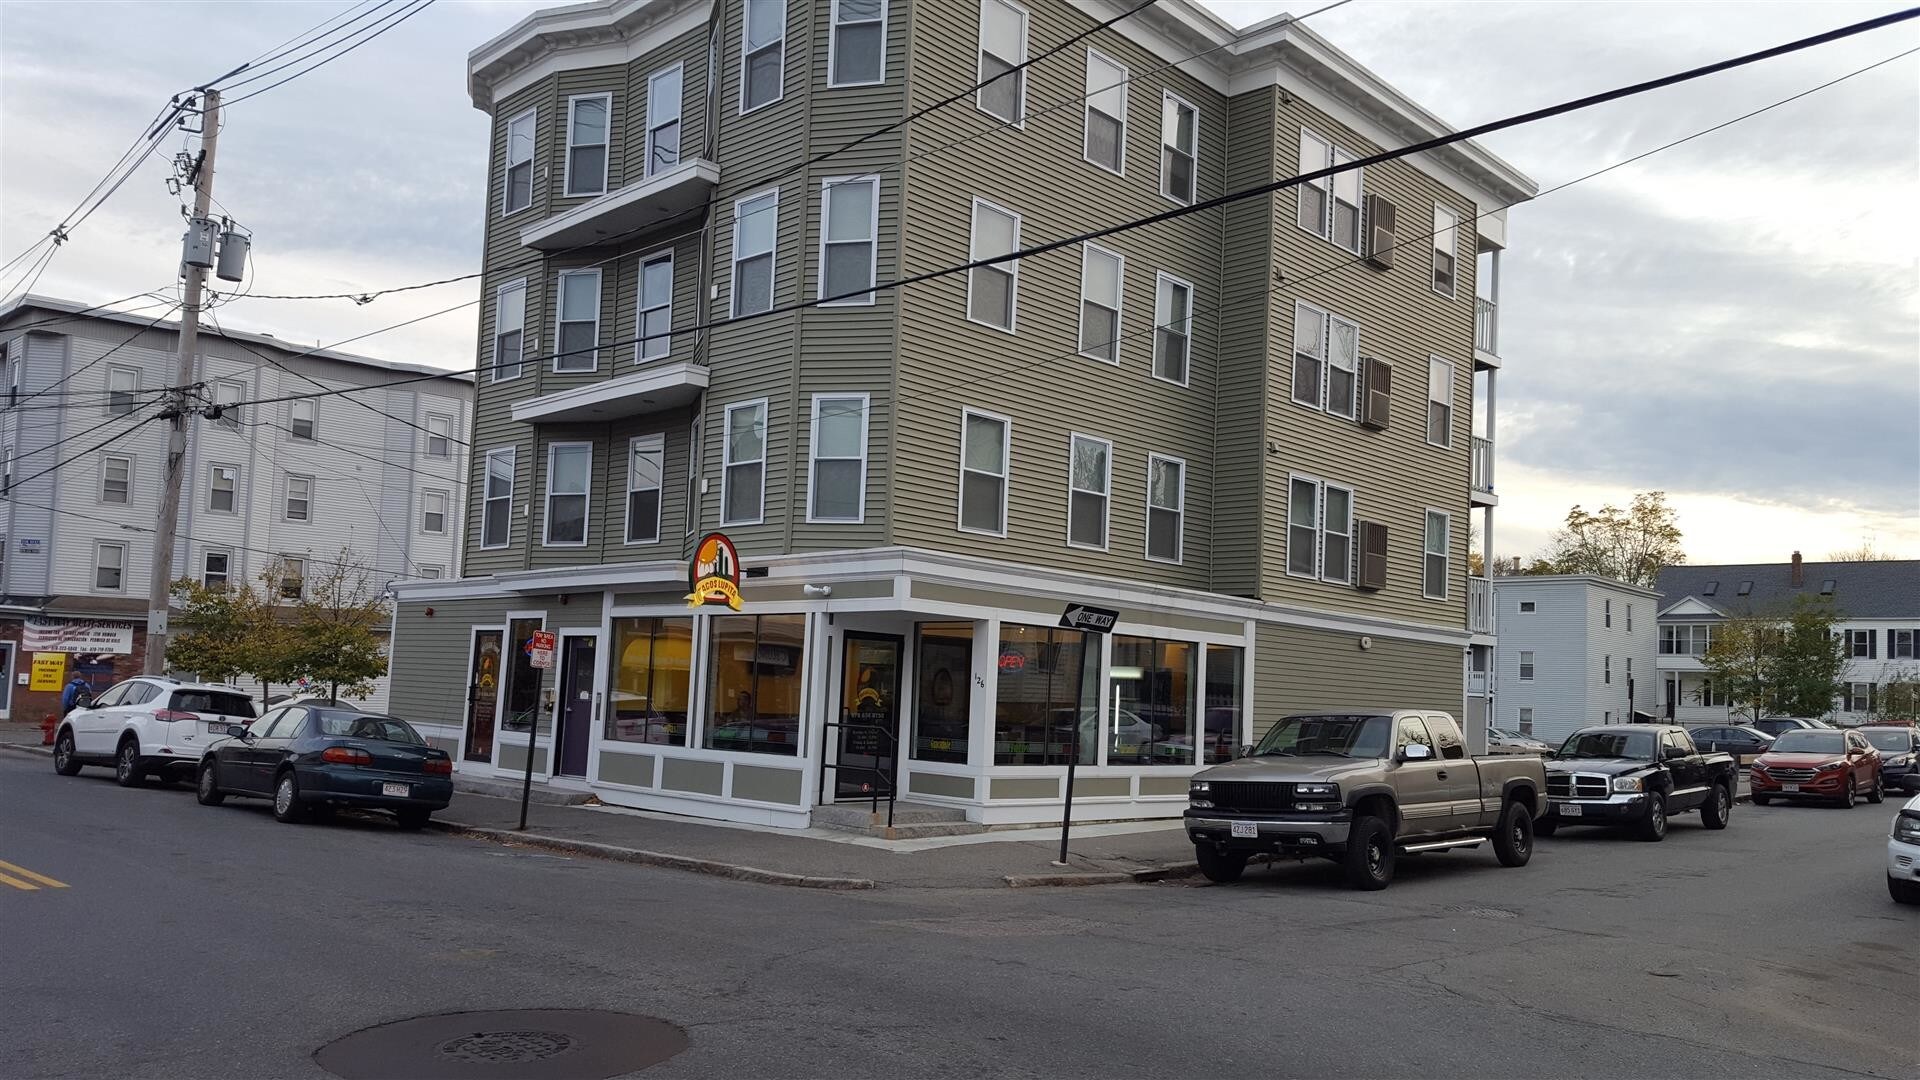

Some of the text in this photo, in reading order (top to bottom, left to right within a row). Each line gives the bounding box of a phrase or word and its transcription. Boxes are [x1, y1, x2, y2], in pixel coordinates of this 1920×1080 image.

[698, 580, 737, 598] TACOS LUPITA
[1077, 612, 1113, 627] ONE WAY
[999, 655, 1025, 668] OPEN
[974, 672, 985, 688] 126
